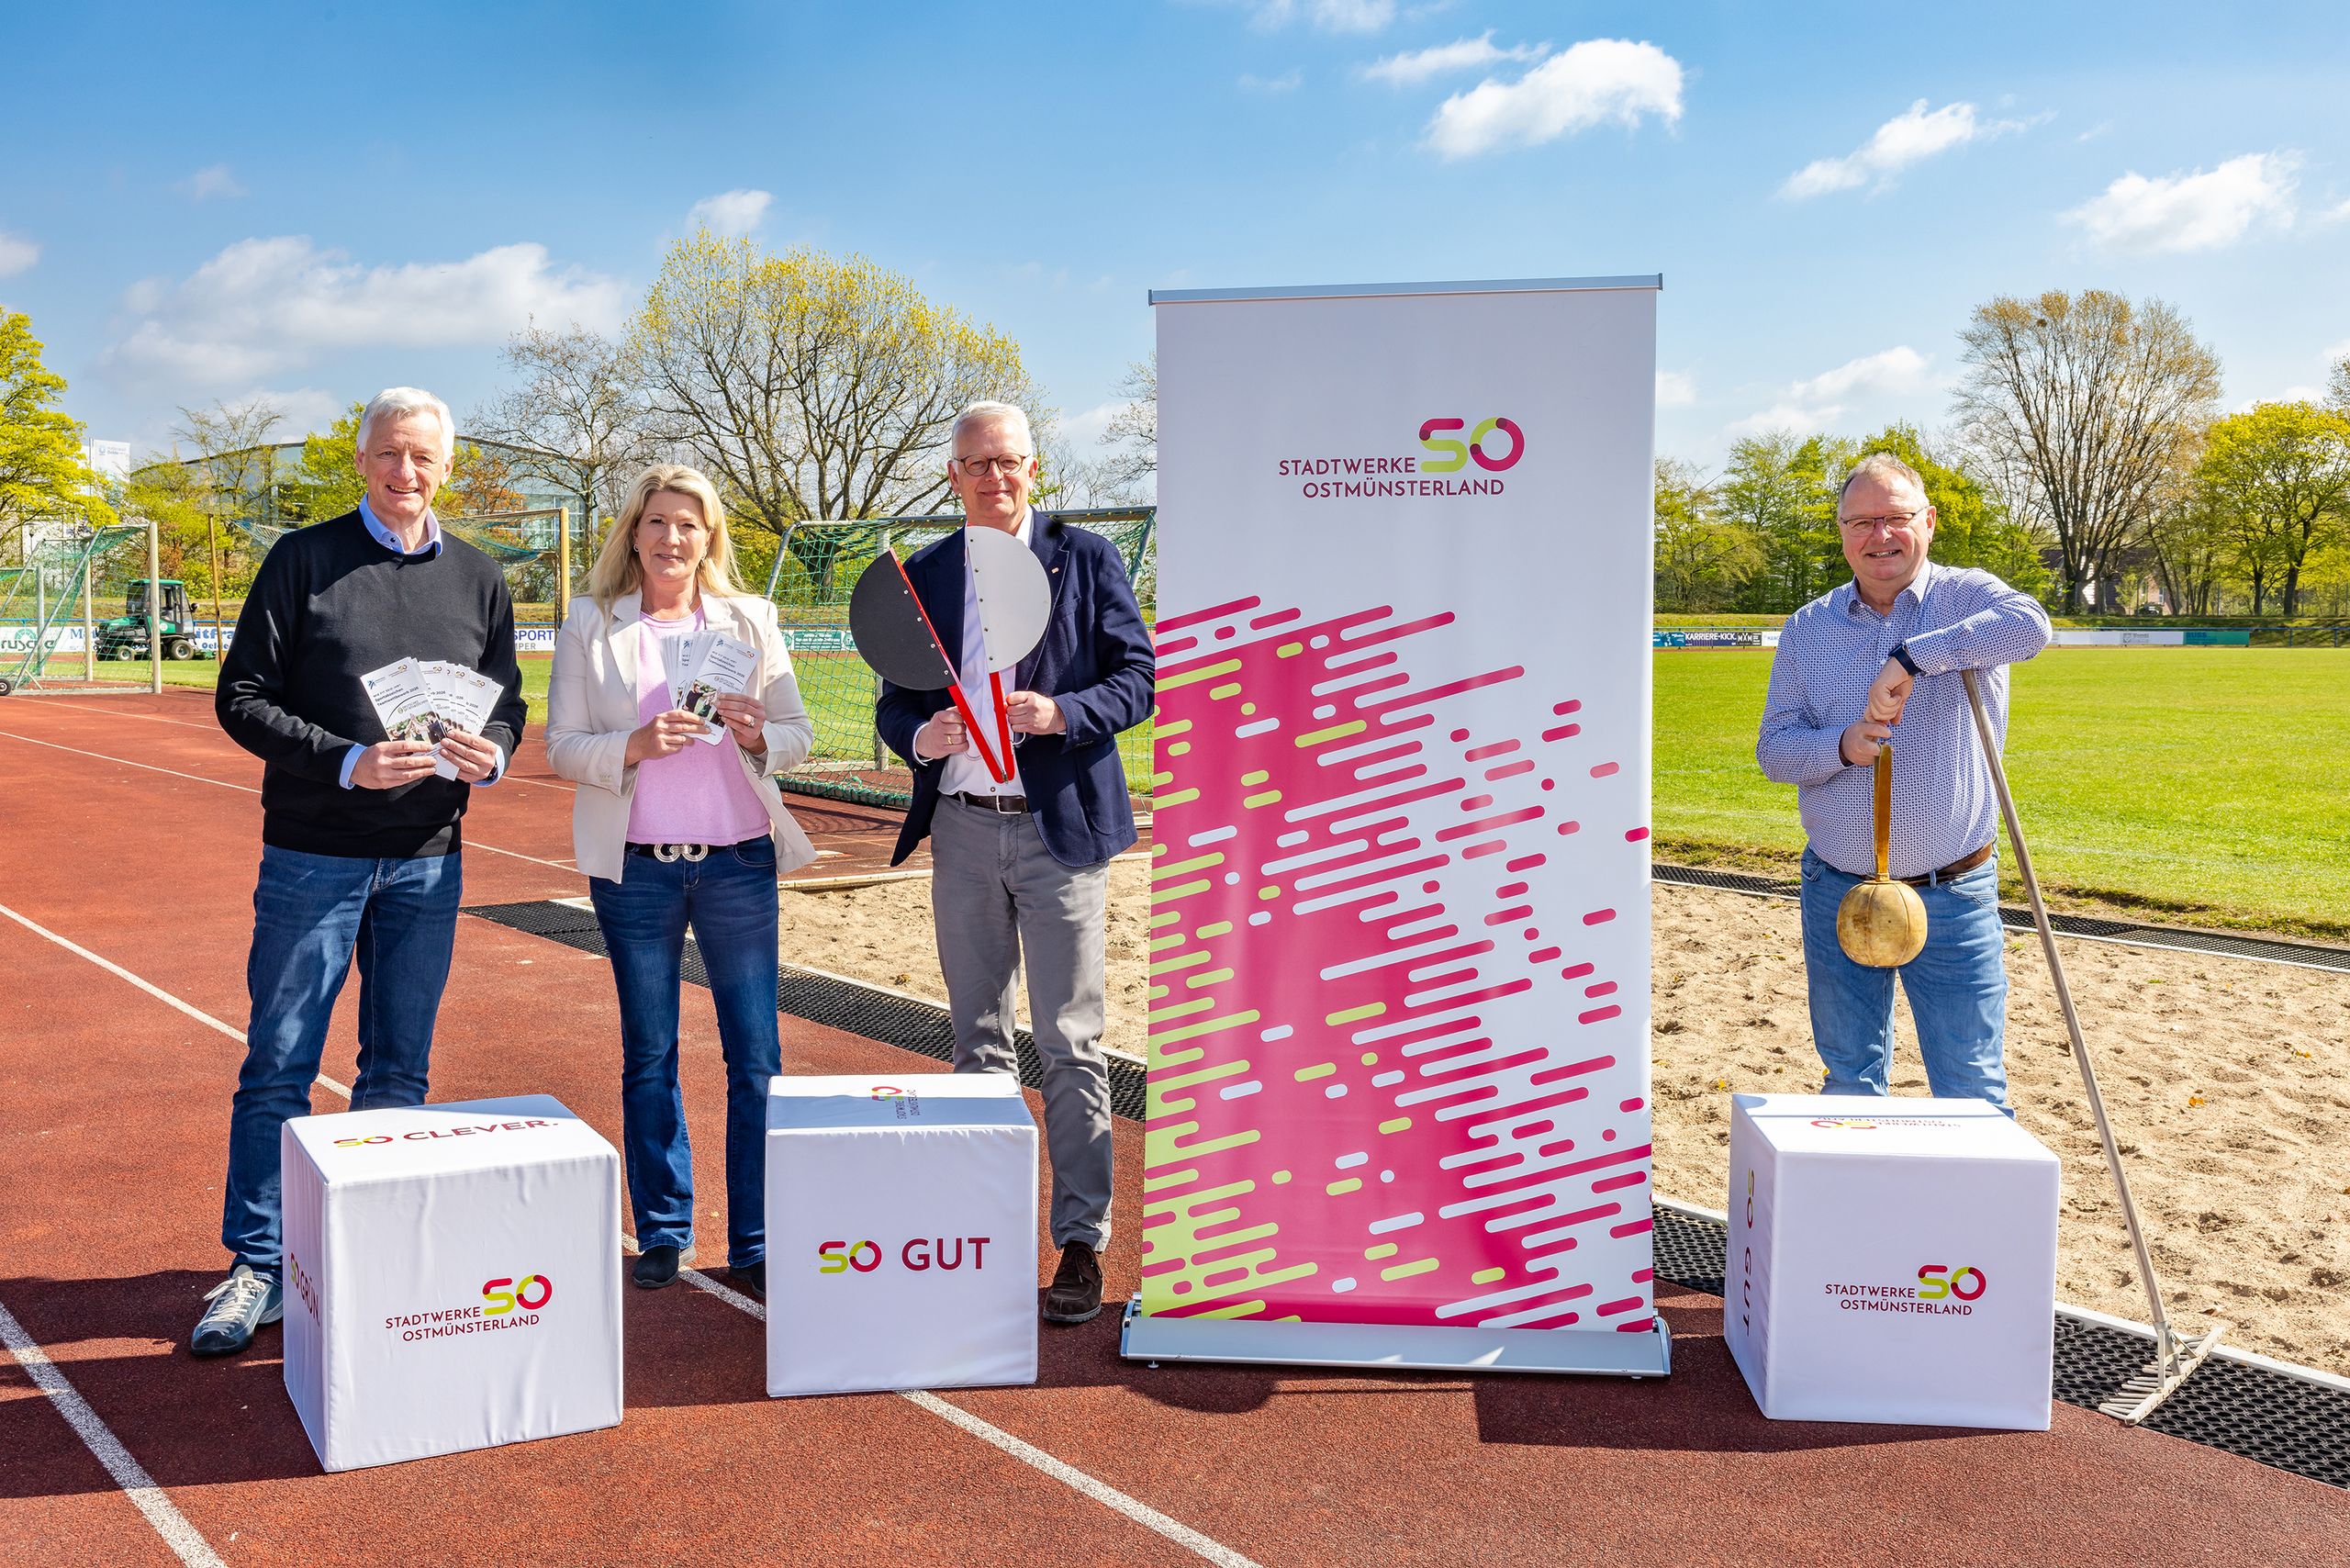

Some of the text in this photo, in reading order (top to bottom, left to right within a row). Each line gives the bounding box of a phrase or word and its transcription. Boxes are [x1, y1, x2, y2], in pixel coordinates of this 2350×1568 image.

[1279, 417, 1526, 476] STADTWERKE SO
[1303, 477, 1505, 498] OSTMÜNSTERLAND
[333, 1120, 559, 1148] SO CLEVER.
[290, 1252, 300, 1290] SO
[818, 1237, 990, 1274] SO GUT
[1742, 1246, 1751, 1337] GUT
[1825, 1264, 1986, 1301] STADTWERKE SO
[385, 1274, 553, 1329] STADTWERKE SO
[1840, 1298, 1973, 1316] OSTMÜNSTERLAND
[402, 1314, 540, 1342] OSTMÜNSTERLAND
